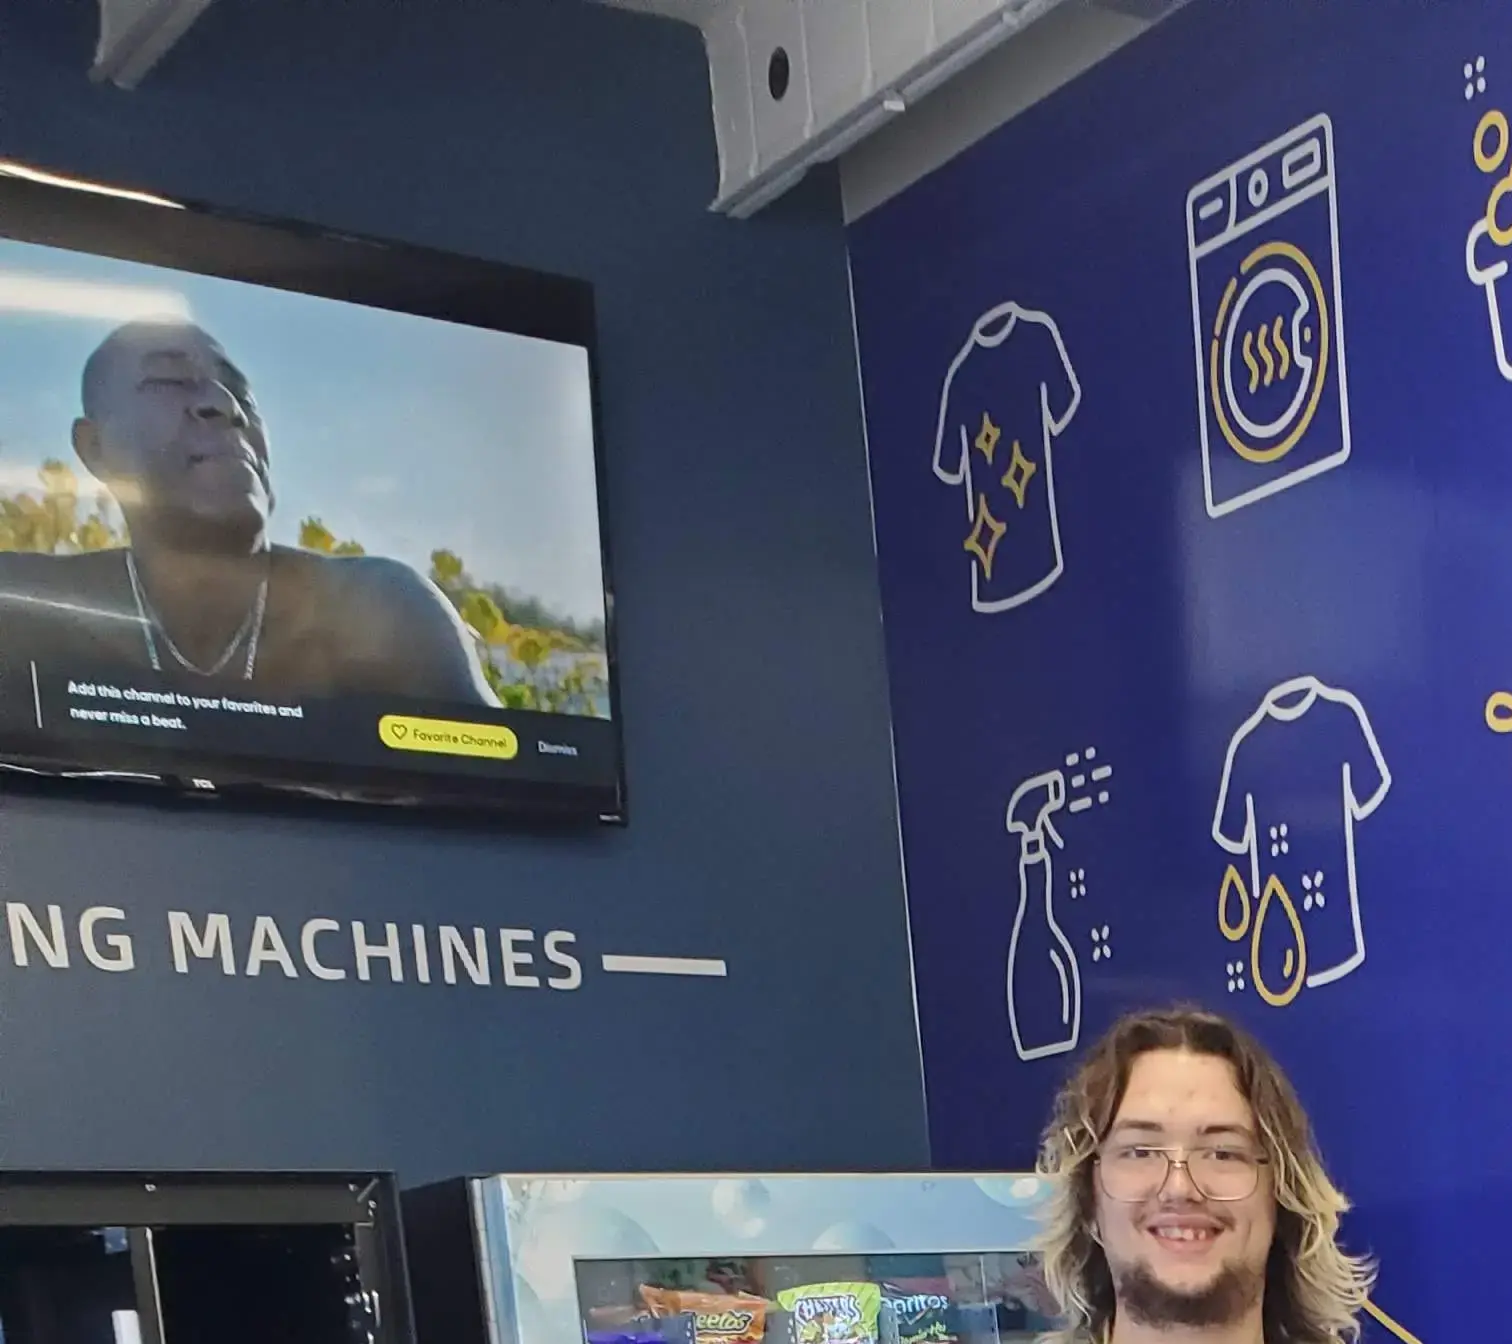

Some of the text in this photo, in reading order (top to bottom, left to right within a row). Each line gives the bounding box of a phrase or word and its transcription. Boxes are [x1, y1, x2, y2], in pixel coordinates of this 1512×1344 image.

[68, 680, 303, 717] Add this channel to your favorites and
[70, 707, 187, 729] never miss a beat.
[413, 728, 507, 750] Favorite Channel
[6, 901, 582, 990] NG MACHINES
[696, 1313, 751, 1331] eetos
